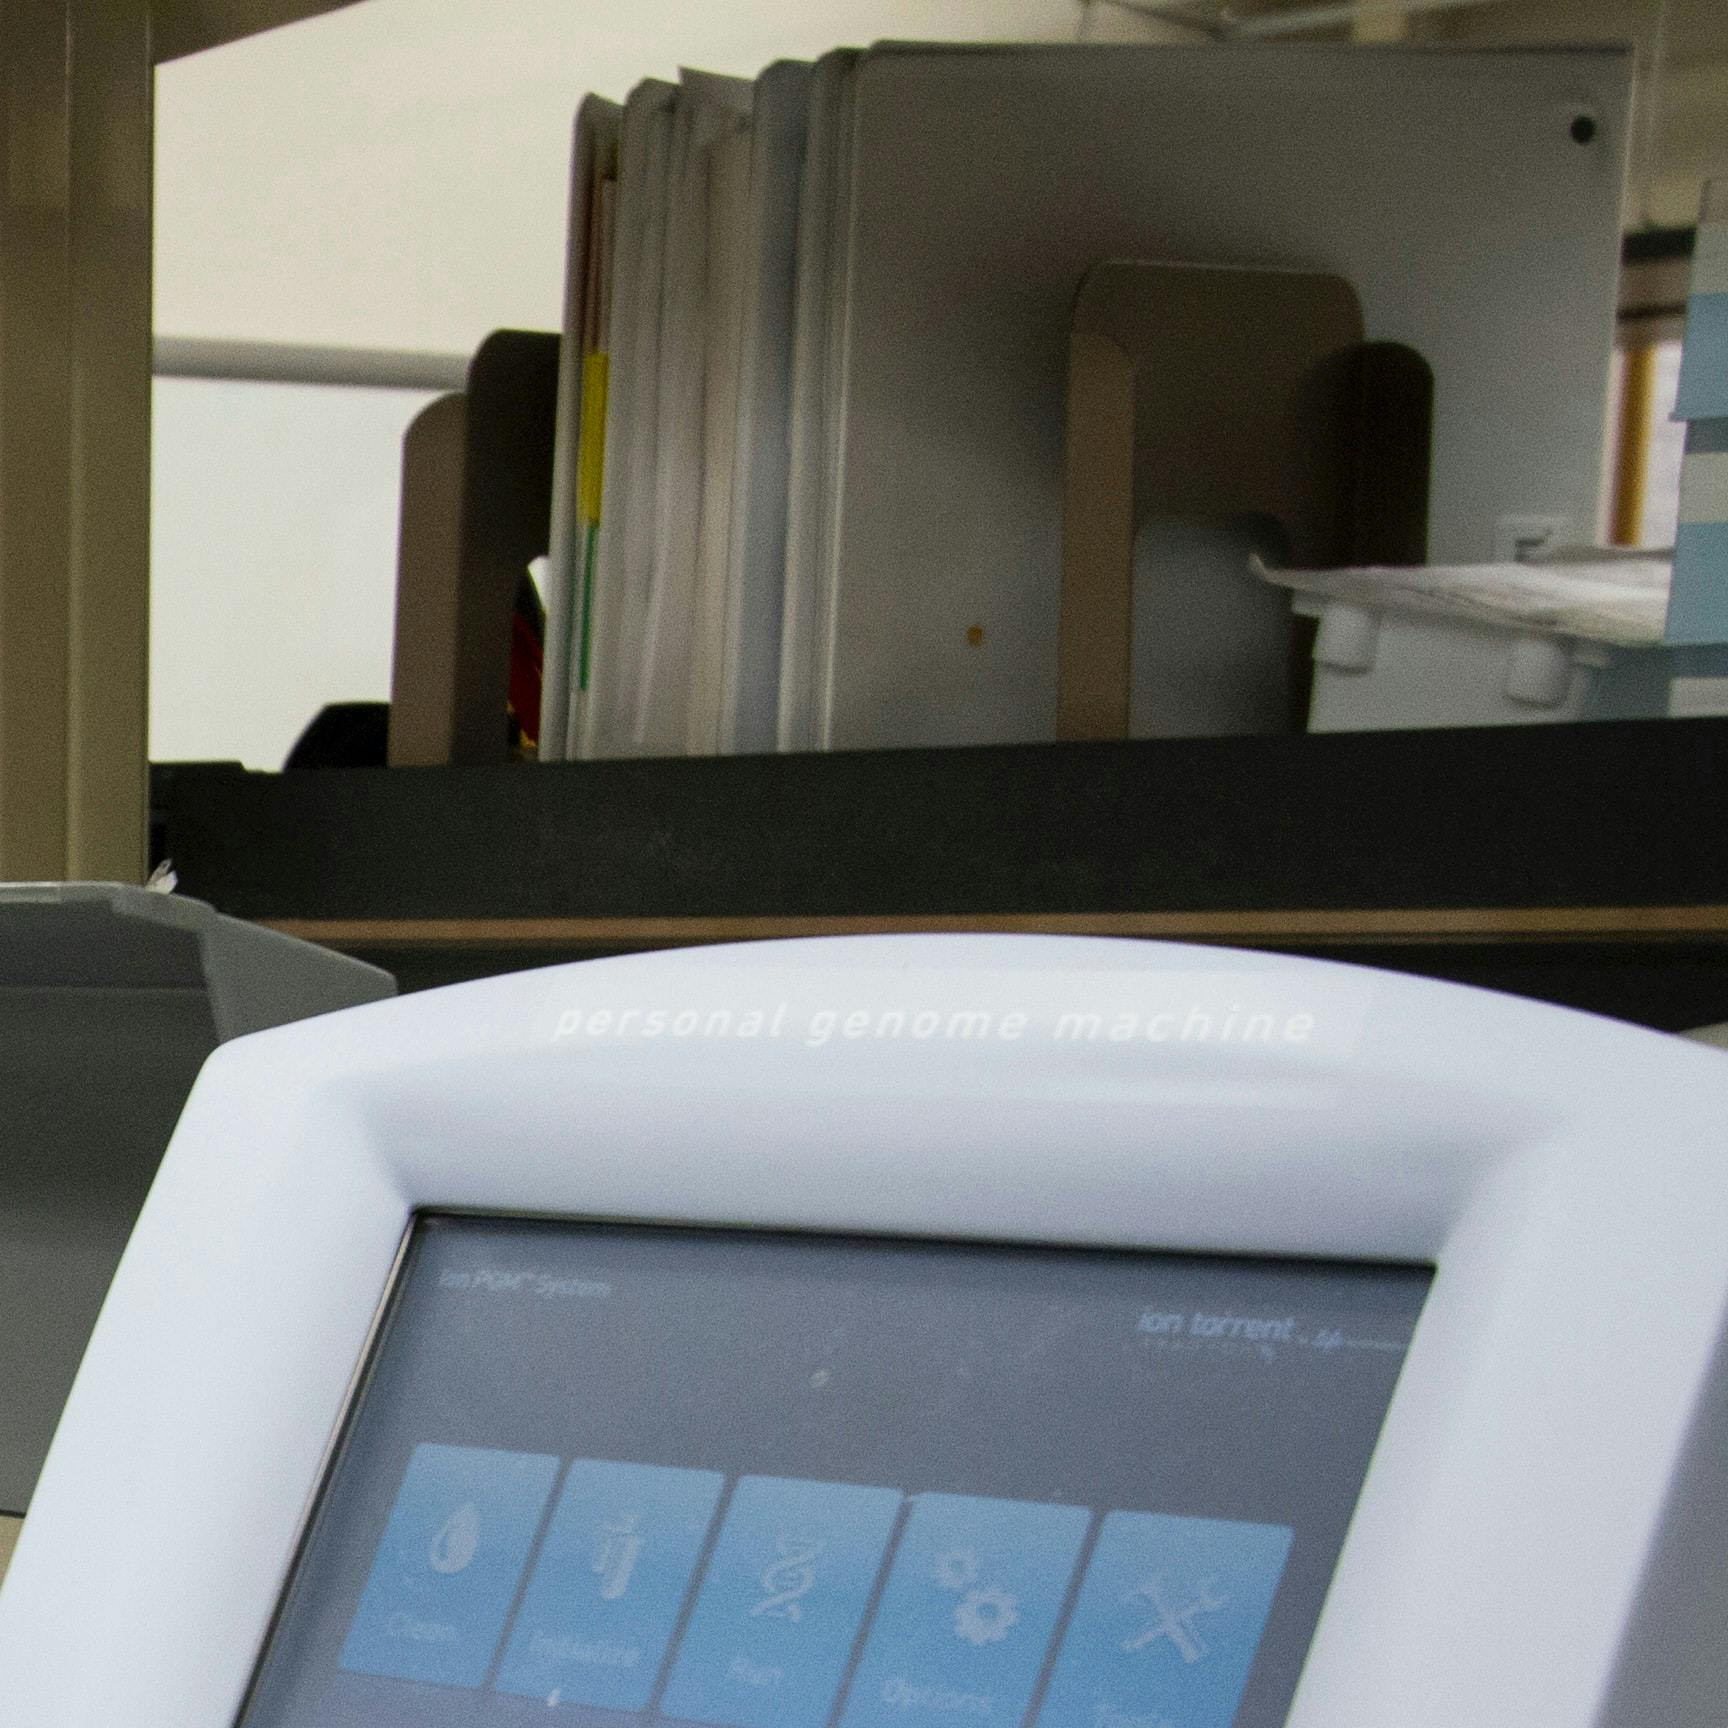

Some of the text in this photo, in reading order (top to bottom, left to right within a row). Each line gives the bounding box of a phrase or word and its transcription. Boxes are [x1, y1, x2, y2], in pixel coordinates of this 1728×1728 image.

[550, 1001, 1315, 1047] personal genome machine
